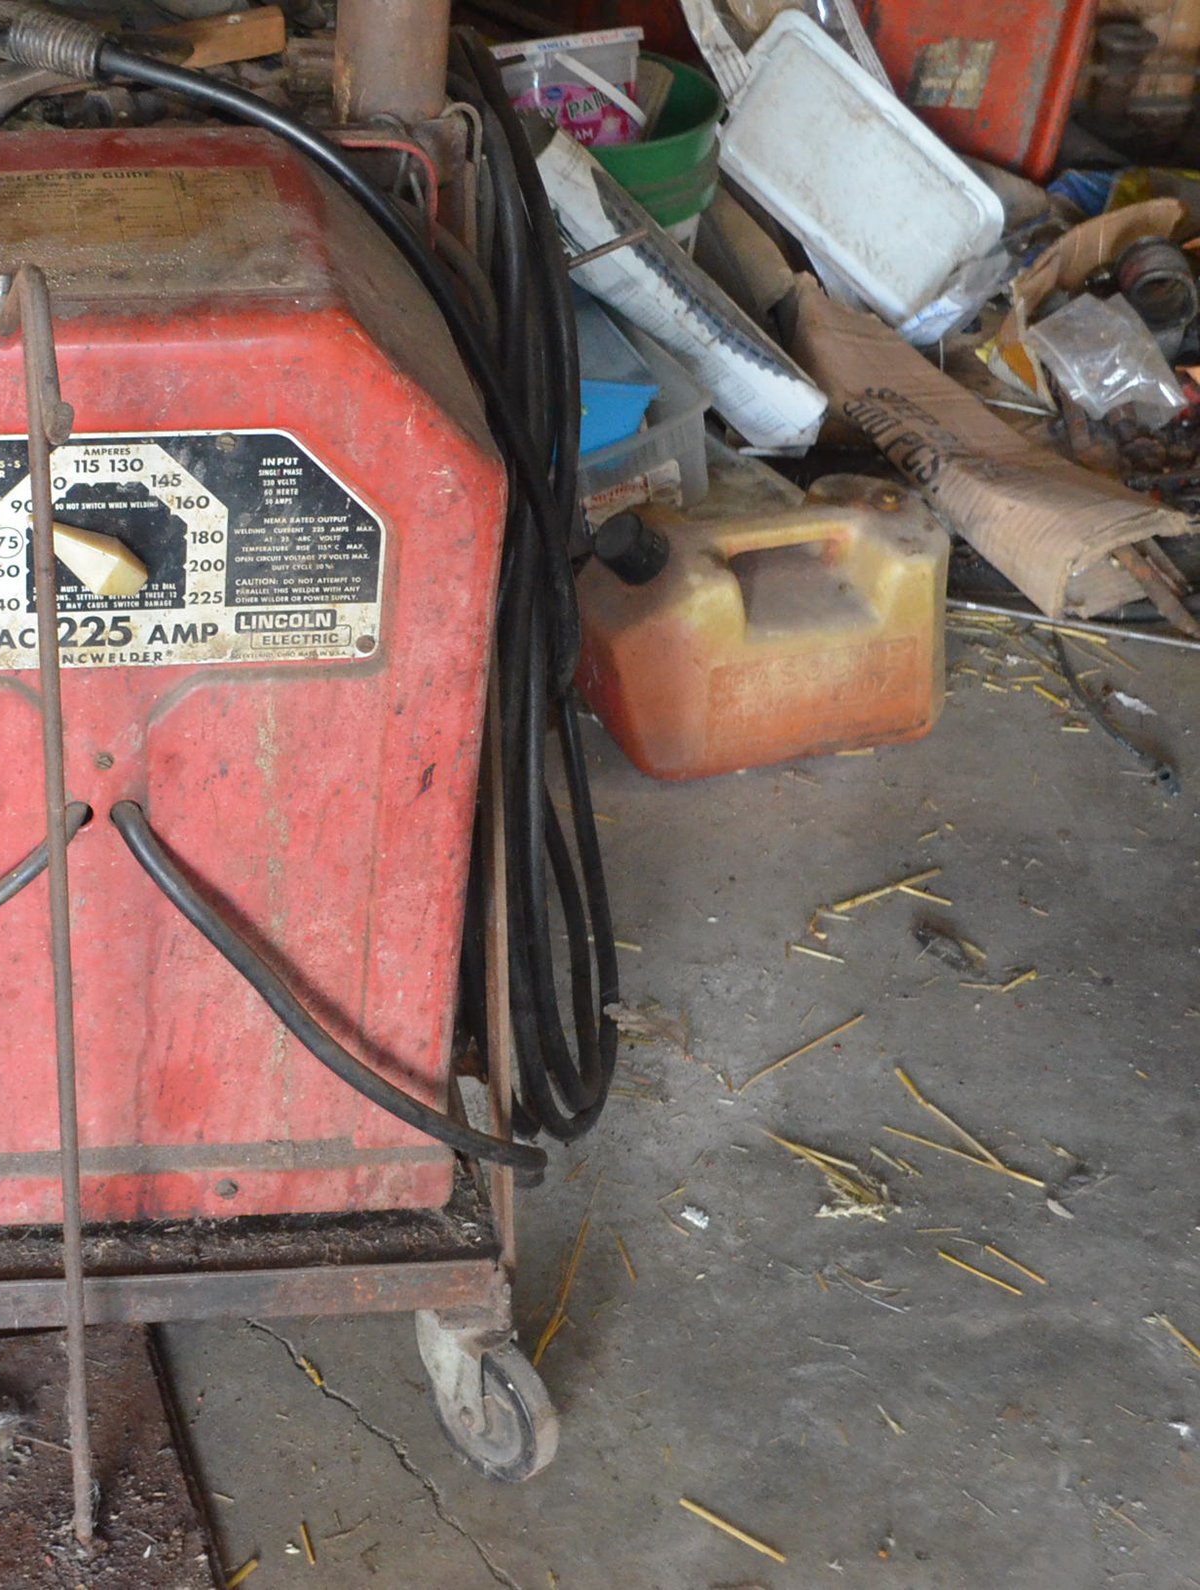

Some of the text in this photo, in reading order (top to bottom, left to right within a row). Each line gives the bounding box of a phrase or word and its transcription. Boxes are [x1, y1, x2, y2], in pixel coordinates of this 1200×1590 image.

[102, 169, 155, 179] GUIDE
[83, 447, 131, 456] AMPERES
[73, 458, 144, 473] 115 130
[262, 457, 299, 466] INPUT
[258, 468, 303, 477] SINGLE PHASE
[151, 473, 182, 488] 145
[263, 478, 297, 487] 230 VOLTS
[276, 488, 299, 496] HERTZ
[54, 500, 159, 511] DO NOT SWITCH WHEN WELDING
[175, 495, 210, 510] 160
[263, 517, 287, 525] NEMA
[317, 516, 347, 524] OUTPUT
[190, 530, 224, 544] 180
[241, 545, 288, 553] TEMPERATURE
[296, 544, 310, 552] RISE
[188, 559, 225, 572] 200
[292, 563, 312, 571] CYCLE
[235, 577, 279, 586] CAUTION:
[283, 578, 295, 586] DO
[298, 577, 314, 585] NOT
[317, 576, 348, 584] ATTEMPT
[60, 585, 78, 593] MUST
[151, 583, 159, 591] 12
[162, 582, 176, 590] DIAL
[235, 588, 270, 596] PARALLEL
[292, 586, 320, 594] WELDER
[144, 591, 164, 599] THESE
[188, 591, 224, 605] 225
[235, 596, 259, 604] OTHER
[303, 594, 330, 602] POWER
[65, 602, 81, 610] MAY
[87, 601, 108, 609] CAUSE
[113, 600, 140, 608] SWITCH
[237, 611, 333, 630] LINCOLN
[57, 615, 133, 649] 225
[146, 622, 219, 645] AMP
[261, 633, 340, 646] ELECTRIC
